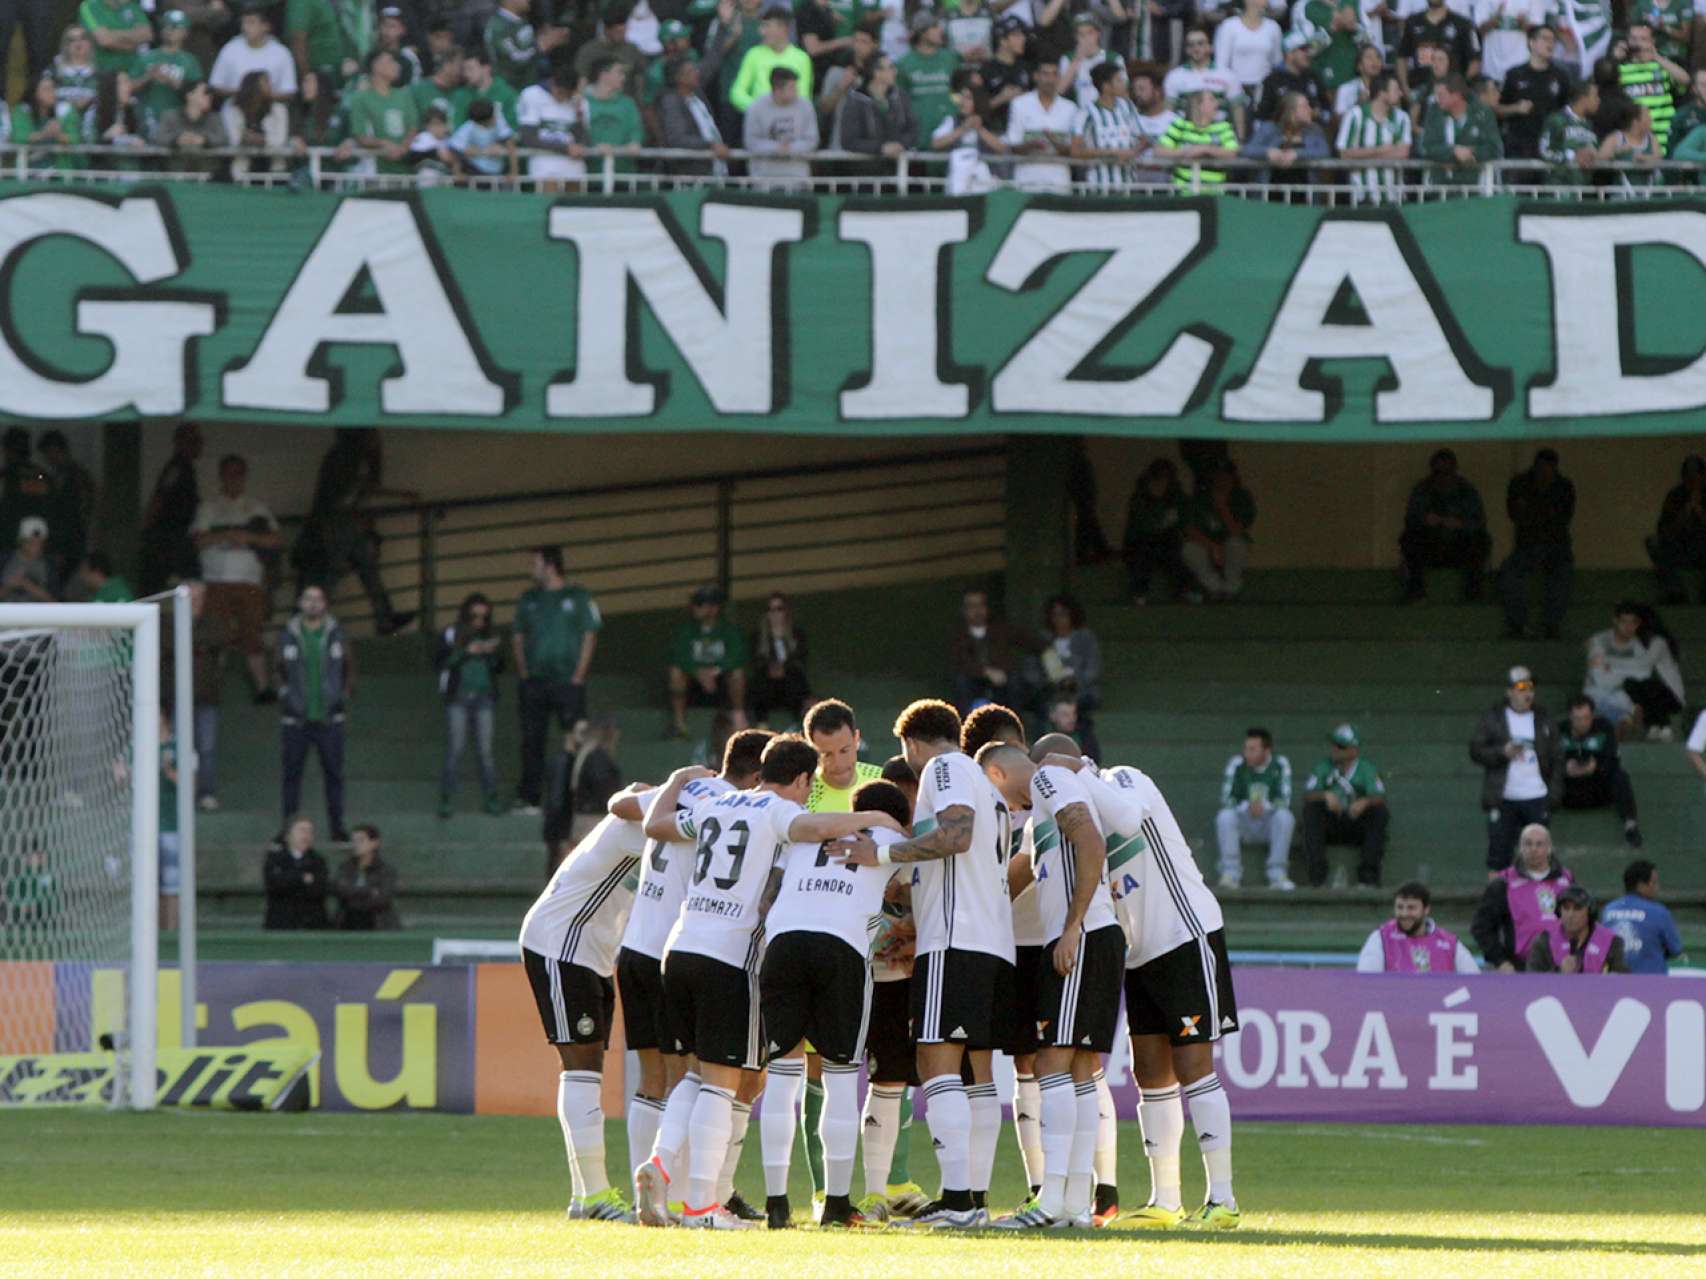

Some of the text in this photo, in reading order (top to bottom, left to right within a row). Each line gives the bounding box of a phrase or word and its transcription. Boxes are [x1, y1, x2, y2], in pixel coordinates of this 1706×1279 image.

[0, 192, 1706, 421] GANIZAD
[693, 816, 750, 891] 83
[797, 878, 854, 896] LEANDRO
